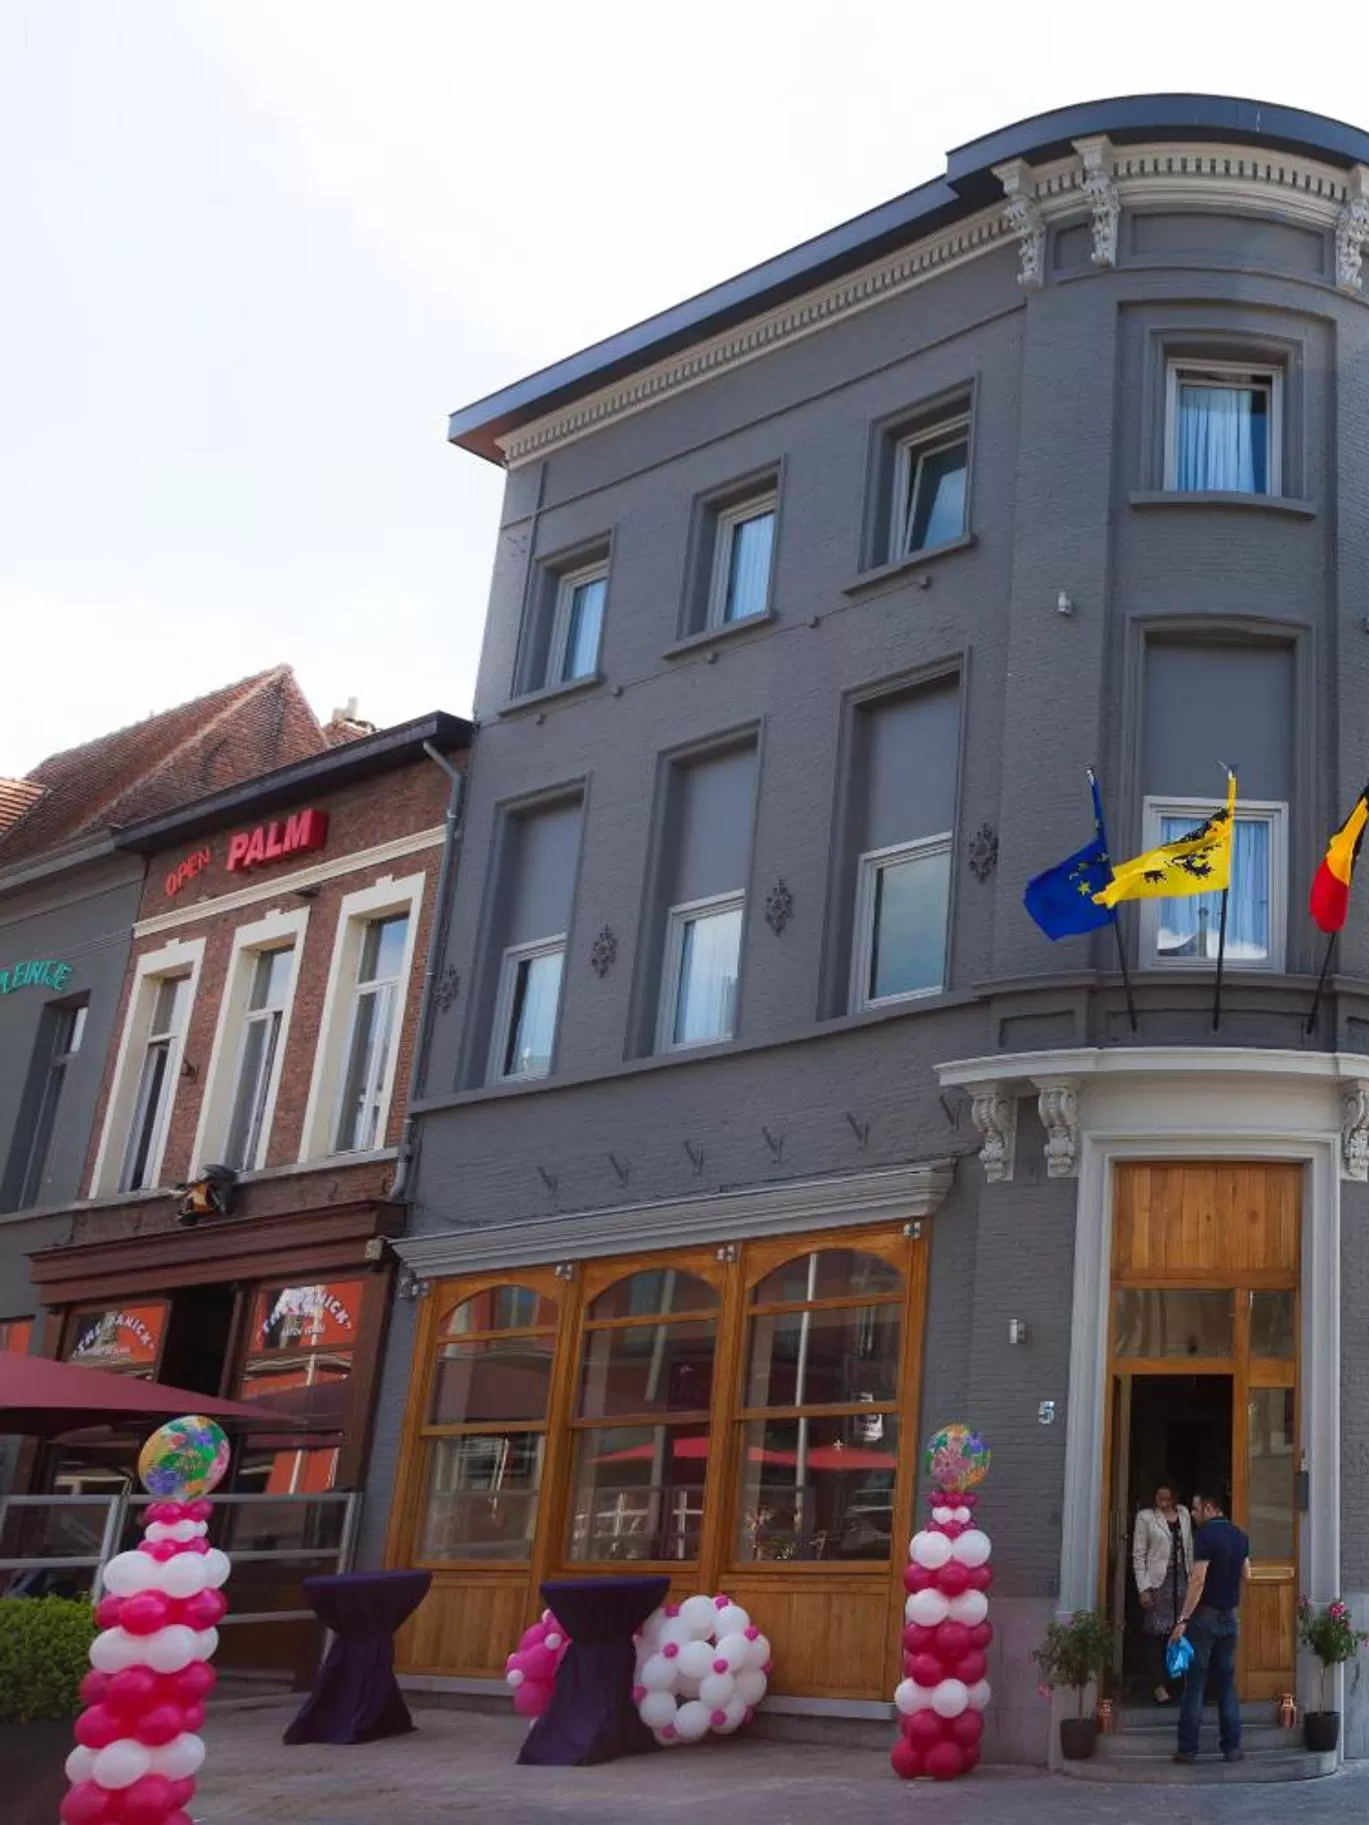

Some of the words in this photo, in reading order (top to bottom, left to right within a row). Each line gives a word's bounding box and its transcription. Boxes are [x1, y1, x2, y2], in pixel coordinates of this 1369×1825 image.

[226, 807, 320, 873] PALM
[164, 846, 212, 897] OPEN
[1037, 1400, 1056, 1425] 5
